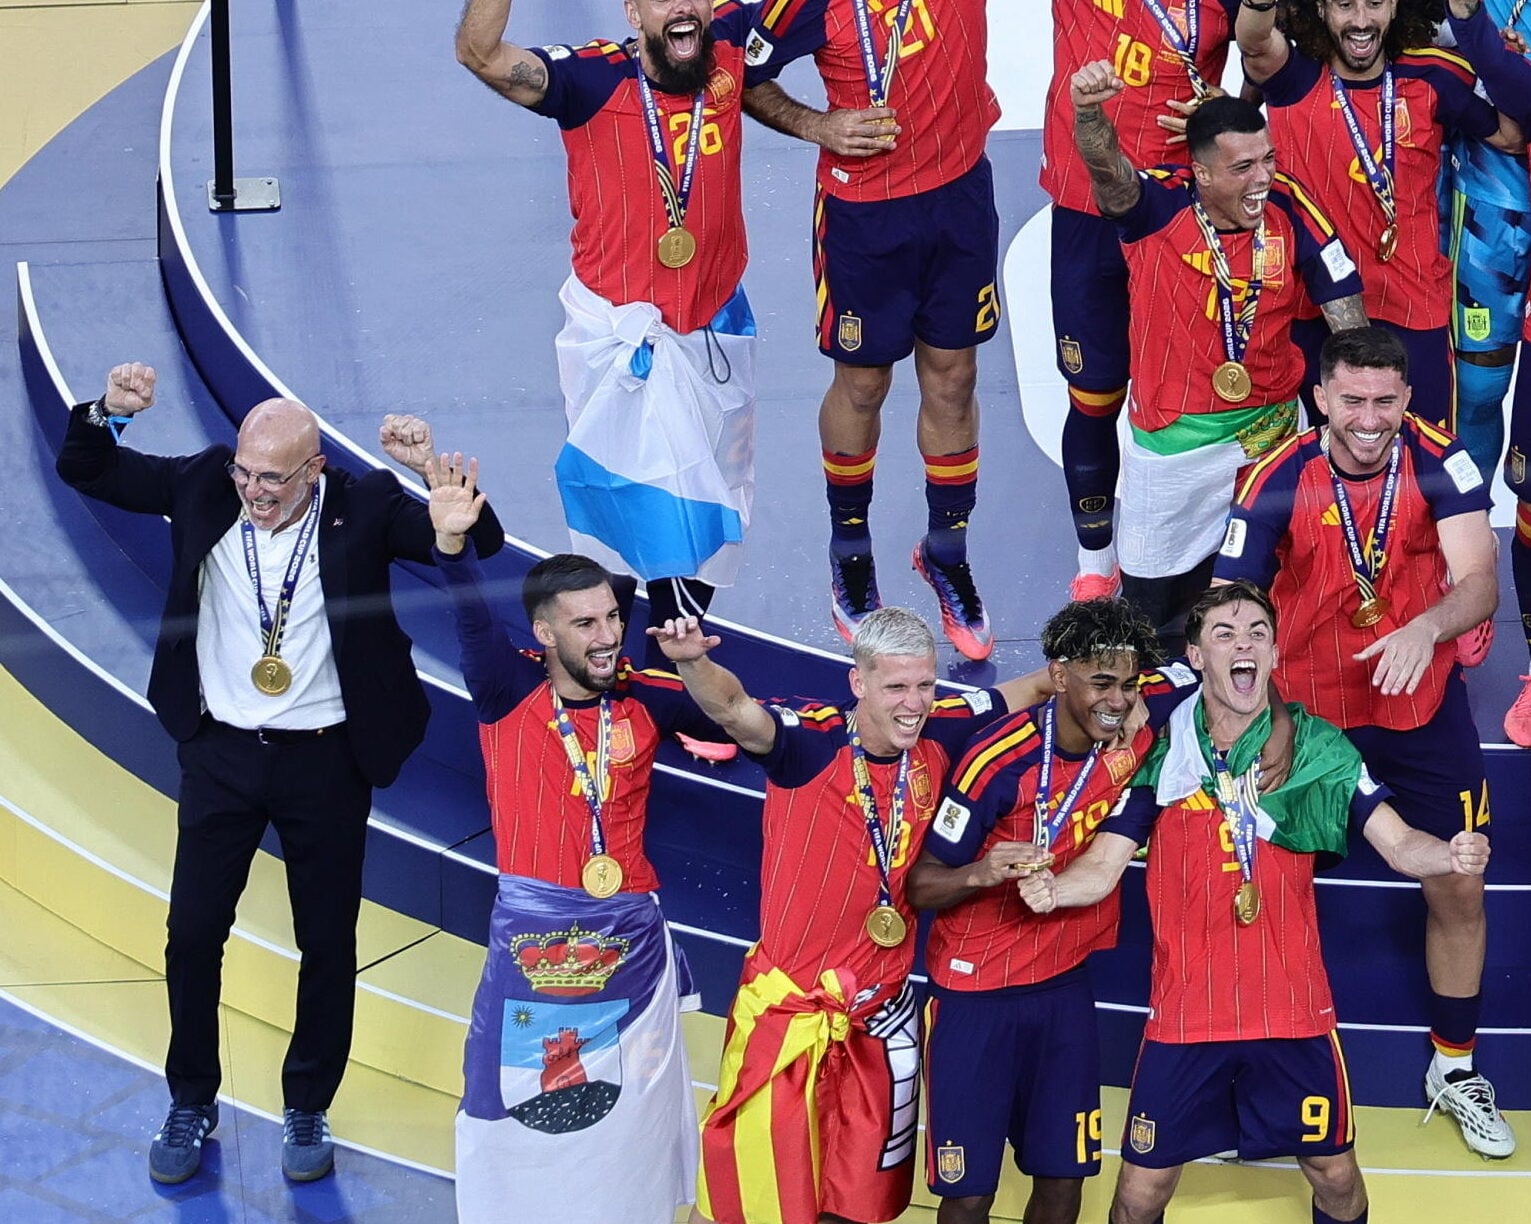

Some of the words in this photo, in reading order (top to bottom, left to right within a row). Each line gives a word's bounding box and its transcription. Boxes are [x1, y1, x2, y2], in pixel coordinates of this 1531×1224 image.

[857, 8, 870, 37] WORLD
[1153, 4, 1165, 20] CUP
[1162, 18, 1181, 43] 2026
[1189, 8, 1197, 38] WORLD
[863, 38, 873, 54] CUP
[866, 54, 878, 82] 2026
[1114, 33, 1153, 87] 18
[1385, 71, 1393, 98] 2026
[648, 109, 660, 129] CUP
[693, 101, 702, 129] 2026
[651, 127, 665, 153] 2026
[668, 112, 723, 167] 26
[690, 129, 699, 147] CUP
[1336, 90, 1347, 108] FIFA
[1343, 106, 1358, 134] WORLD
[1354, 133, 1365, 149] CUP
[1361, 148, 1377, 175] 2026
[1384, 115, 1392, 143] WORLD
[686, 147, 697, 175] WORLD
[1223, 297, 1232, 322] 2026
[1225, 323, 1233, 337] CUP
[1390, 446, 1399, 473] 2026
[1335, 483, 1346, 501] FIFA
[1386, 474, 1394, 490] CUP
[1340, 500, 1352, 526] WORLD
[1381, 490, 1392, 518] WORLD
[245, 531, 254, 548] FIFA
[1346, 526, 1356, 542] CUP
[1377, 518, 1385, 534] FIFA
[296, 539, 308, 556] CUP
[1350, 541, 1363, 566] 2026
[247, 548, 259, 577] WORLD
[287, 555, 303, 583] 2026
[1045, 708, 1053, 724] FIFA
[1044, 723, 1052, 749] WORLD
[1041, 763, 1049, 787] 2026
[1053, 811, 1065, 827] FIFA
[1060, 789, 1078, 813] WORLD
[1080, 756, 1095, 778] 2026
[872, 828, 882, 846] FIFA
[1072, 799, 1110, 850] 19
[1301, 1095, 1331, 1142] 9
[1075, 1108, 1102, 1164] 19
